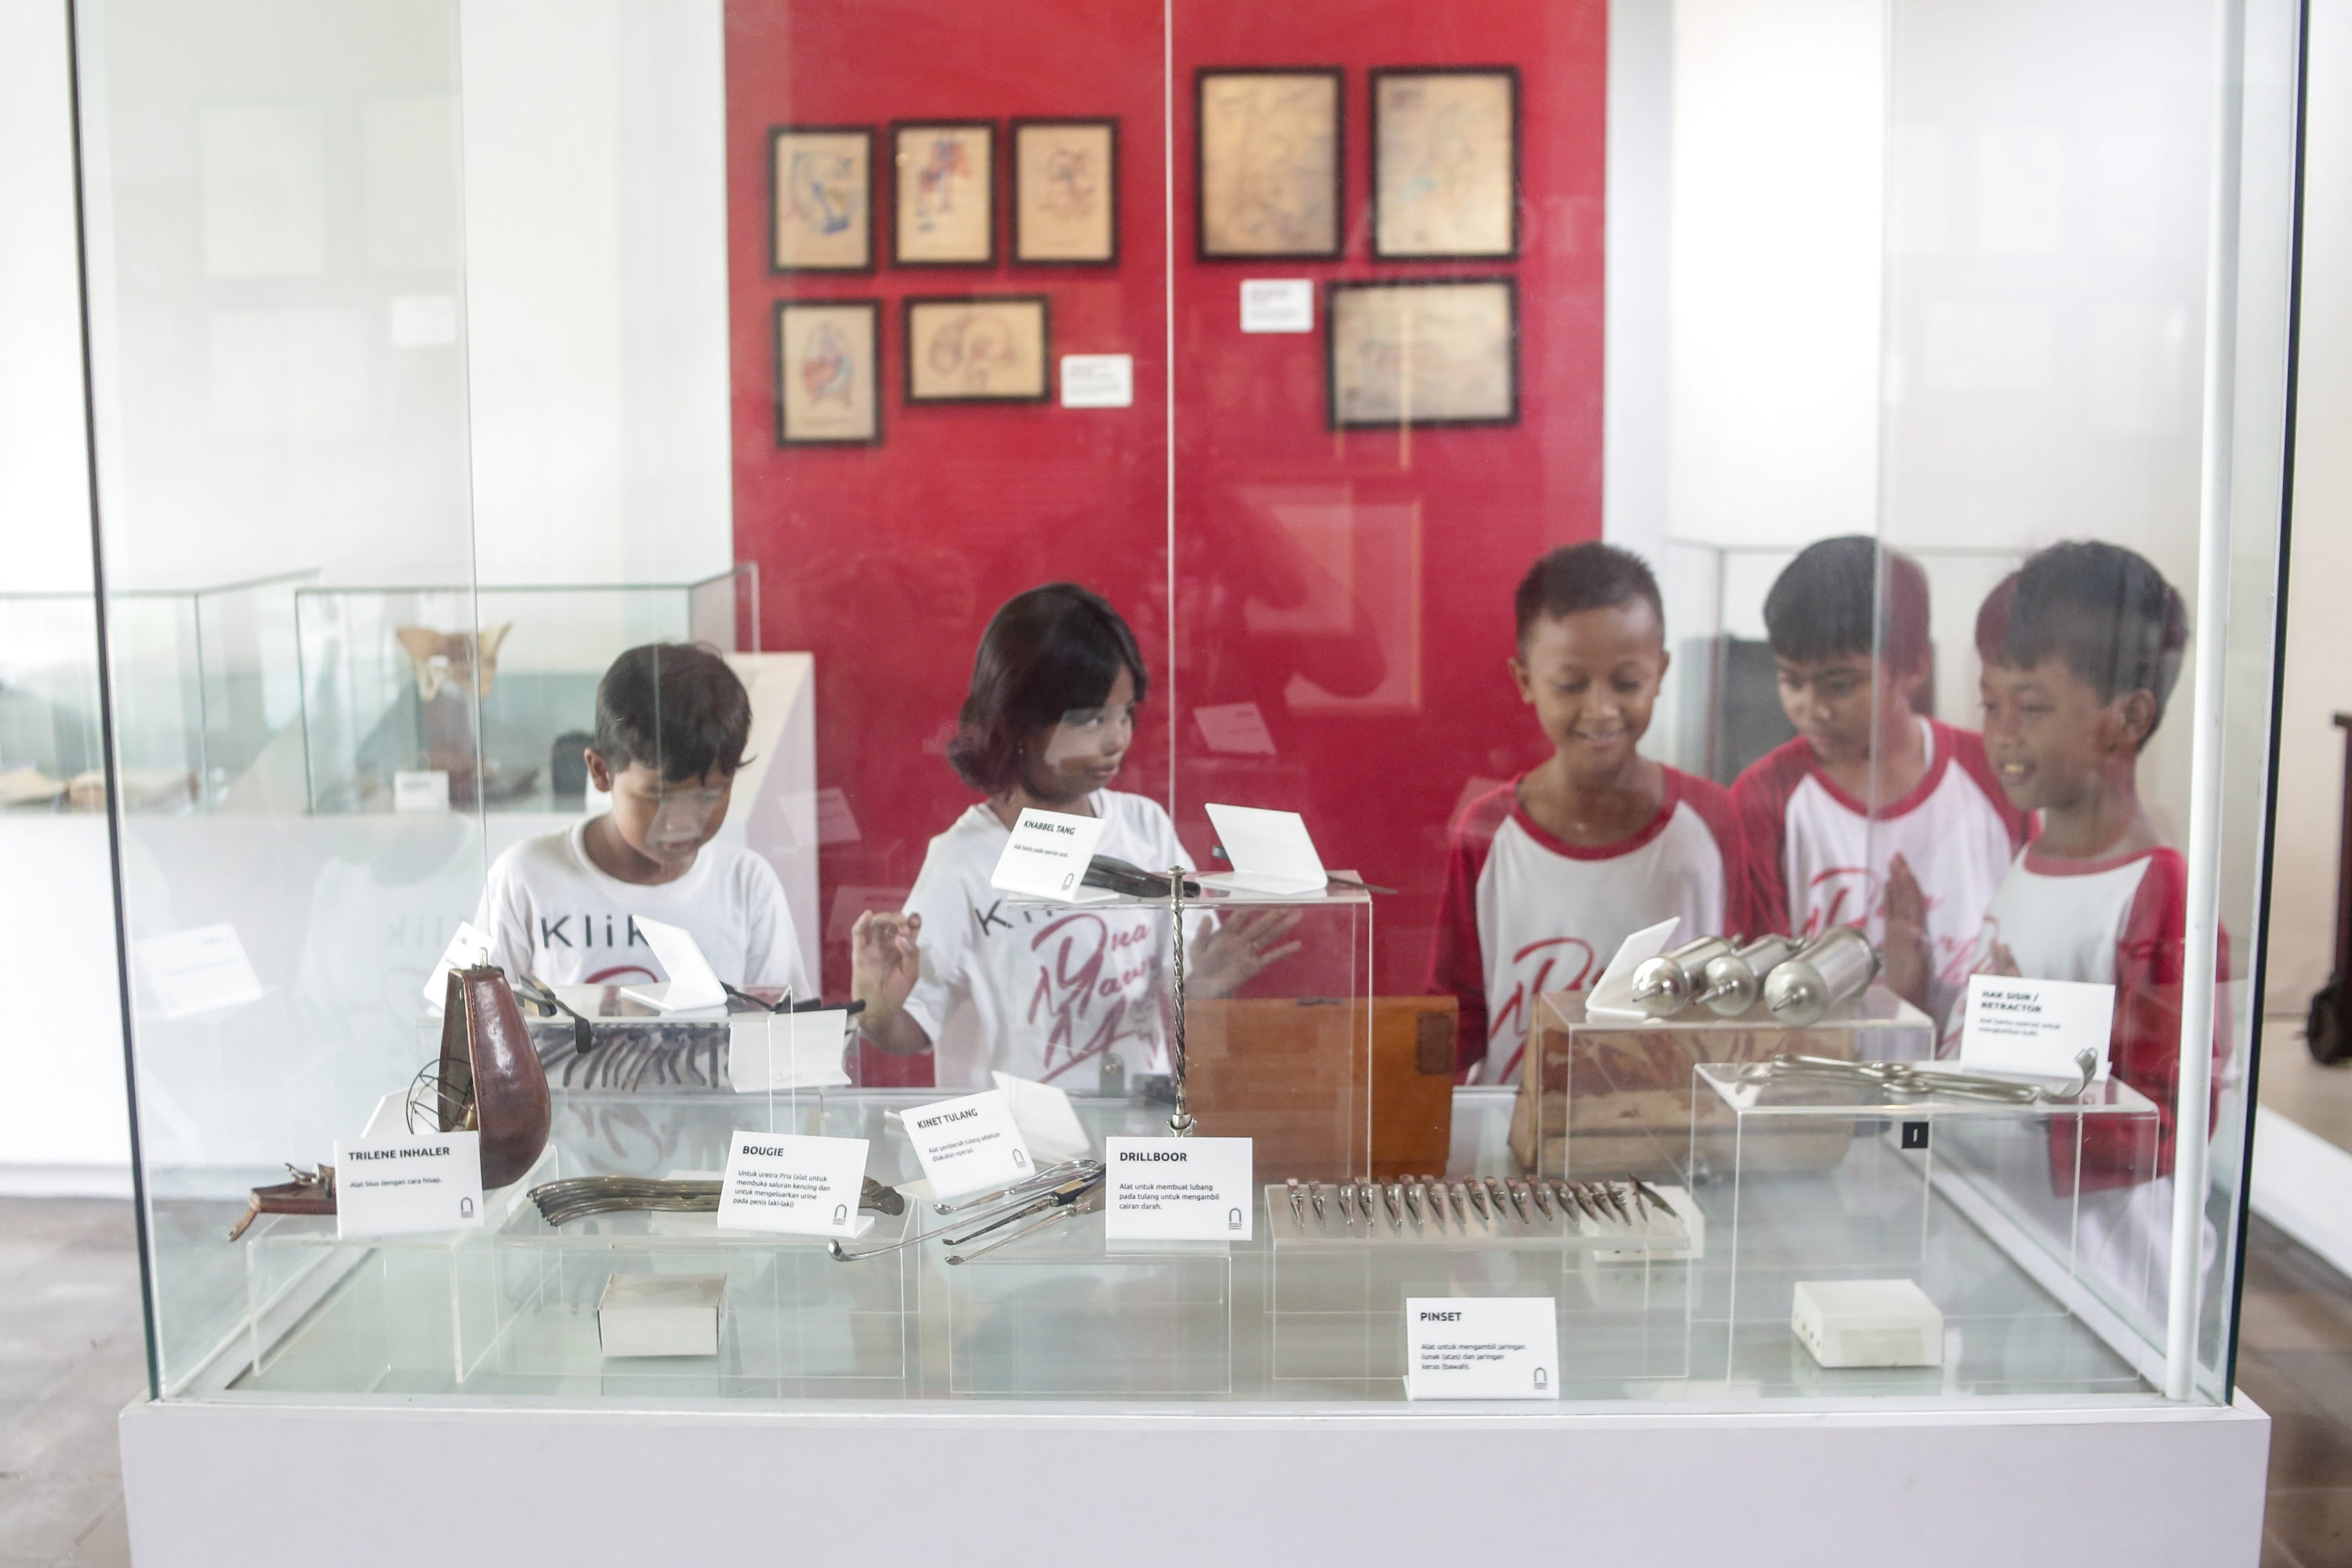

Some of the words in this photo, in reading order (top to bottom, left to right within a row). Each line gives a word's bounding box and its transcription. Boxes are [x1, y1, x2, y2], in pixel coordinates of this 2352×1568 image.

[1023, 819, 1054, 832] KNABBEL
[1056, 825, 1076, 835] TANG
[1980, 1001, 2042, 1012] RETRACTOR
[916, 1116, 942, 1129] KINET
[943, 1108, 978, 1123] TULANG
[939, 1139, 965, 1152] pembersih
[964, 1136, 981, 1145] tulang
[980, 1131, 1001, 1142] sebelum
[348, 1149, 396, 1161] TRILENE
[399, 1147, 450, 1159] INHALER
[742, 1145, 784, 1156] BOUGIE
[931, 1152, 956, 1162] dilakukan
[1120, 1152, 1187, 1162] DRILLBOOR
[381, 1178, 405, 1187] dengan
[1189, 1183, 1213, 1192] lubang
[754, 1189, 799, 1199] mengeluarkan
[768, 1200, 794, 1208] laki-laki)
[1421, 1312, 1462, 1321] PINSET
[1458, 1343, 1497, 1352] mengambil
[1497, 1343, 1526, 1352] jaringan
[1441, 1352, 1461, 1361] (atas)
